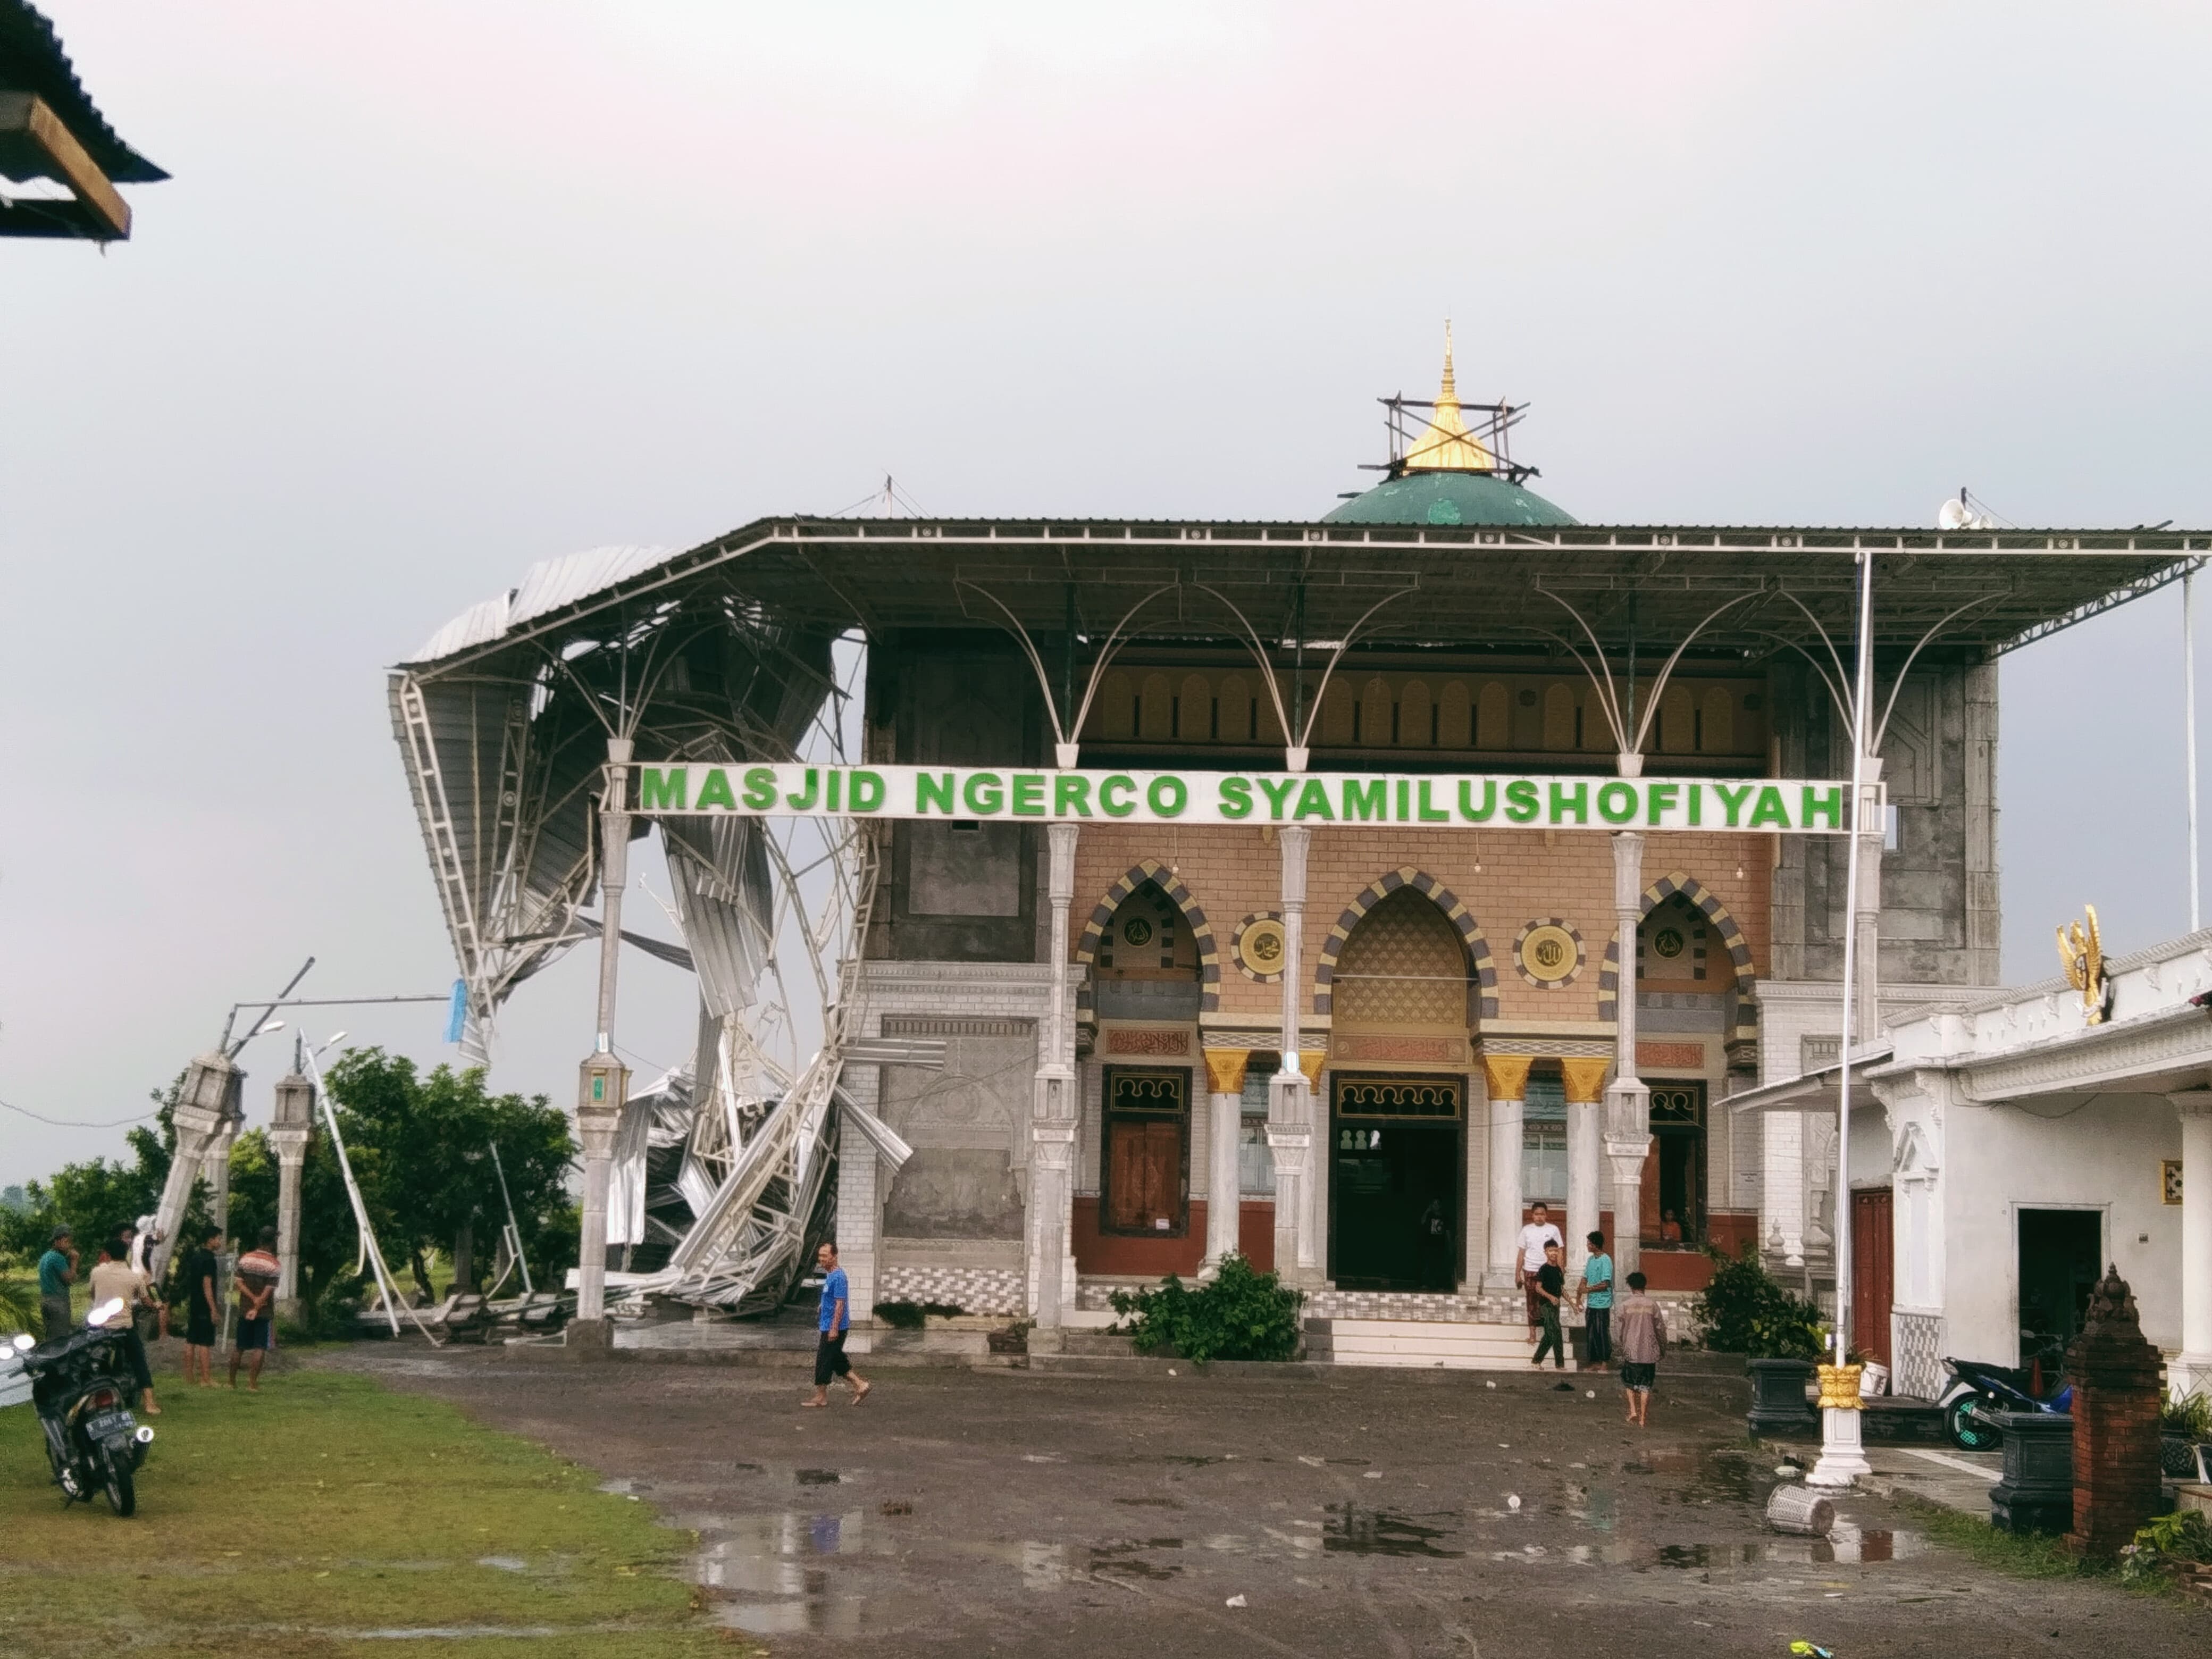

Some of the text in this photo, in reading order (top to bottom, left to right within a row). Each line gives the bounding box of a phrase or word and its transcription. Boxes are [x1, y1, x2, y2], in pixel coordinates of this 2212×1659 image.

[642, 768, 1841, 827] MASJID NGERCO SYAMILUSHOFIYAH
